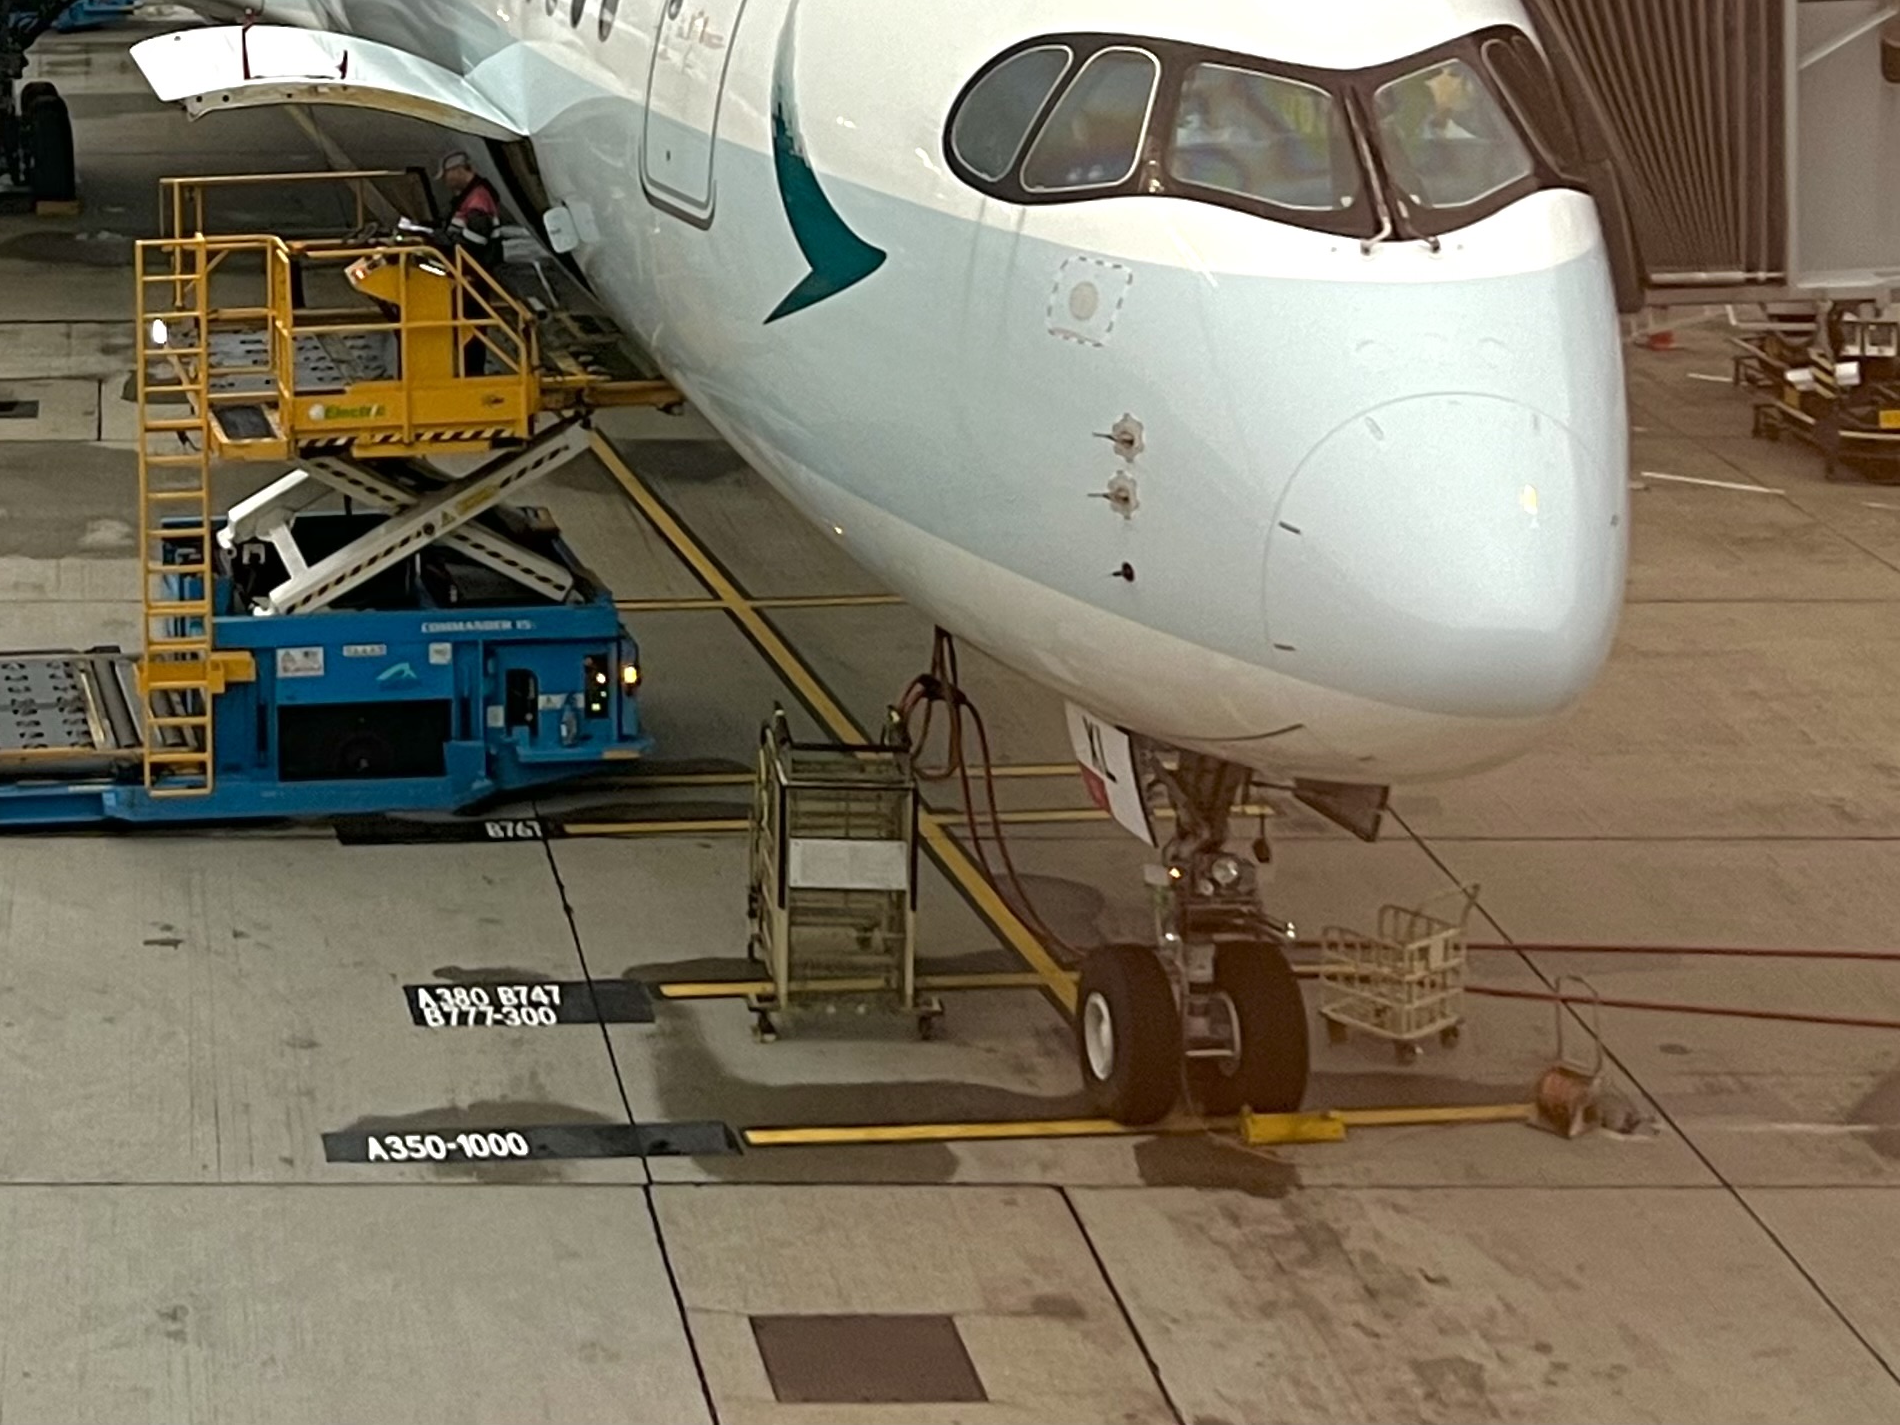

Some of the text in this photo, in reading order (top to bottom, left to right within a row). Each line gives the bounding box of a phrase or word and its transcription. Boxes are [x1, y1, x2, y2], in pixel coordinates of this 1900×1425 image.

[485, 820, 543, 839] B767
[418, 984, 560, 1012] A380 B747
[423, 1005, 557, 1028] B777-300
[368, 1132, 529, 1162] A350-1000
